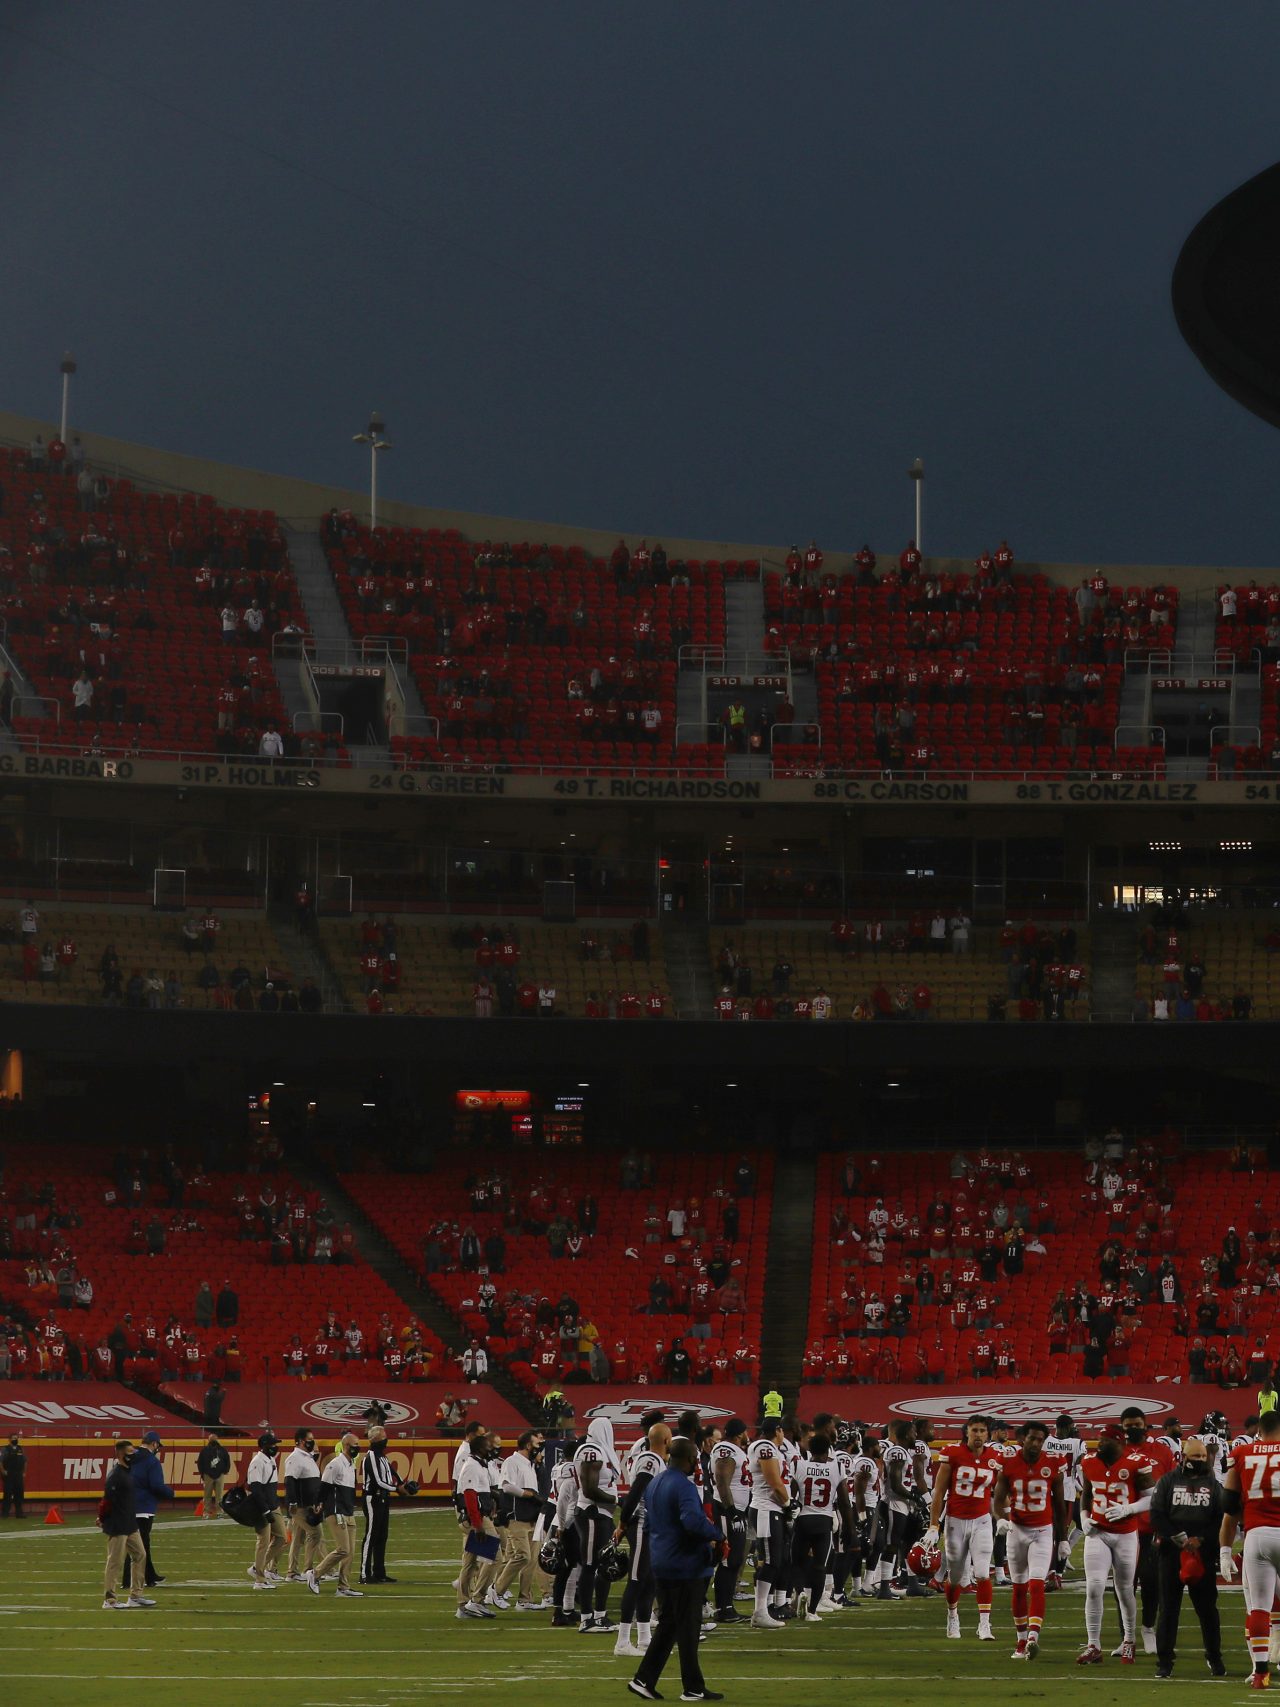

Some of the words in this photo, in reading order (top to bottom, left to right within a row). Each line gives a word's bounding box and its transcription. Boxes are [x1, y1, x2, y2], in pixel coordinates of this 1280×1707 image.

[807, 554, 815, 562] 10
[999, 553, 1008, 561] 15
[1094, 581, 1103, 589] 15
[640, 623, 650, 632] 35
[356, 667, 381, 677] 310
[712, 676, 737, 686] 310
[757, 676, 781, 686] 311
[1157, 679, 1180, 688] 311
[1202, 679, 1226, 688] 312
[917, 750, 927, 758] 15
[25, 757, 133, 780] BARBARO
[182, 766, 200, 782] 31
[205, 767, 222, 784] P.
[229, 765, 321, 788] HOLMES
[369, 775, 393, 789] 24
[430, 776, 505, 794] GREEN
[554, 779, 579, 794] 49
[584, 779, 603, 796] T.
[610, 780, 761, 799] RICHARDSON
[814, 784, 838, 798] 88
[844, 782, 866, 800] C.
[871, 784, 968, 801] CARSON
[1017, 784, 1041, 800] 88
[1047, 784, 1063, 800] T.
[1069, 783, 1197, 800] GONZALEZ
[1245, 785, 1270, 800] 54
[204, 919, 215, 929] 15
[840, 924, 846, 934] 7
[1168, 937, 1177, 946] 15
[62, 944, 72, 954] 15
[503, 945, 514, 954] 15
[367, 959, 377, 968] 15
[1069, 969, 1080, 980] 82
[650, 999, 661, 1008] 15
[720, 1001, 731, 1010] 58
[815, 1000, 825, 1012] 15
[475, 1190, 484, 1200] 10
[295, 1208, 305, 1218] 15
[1113, 1204, 1123, 1213] 87
[961, 1227, 969, 1236] 15
[963, 1272, 974, 1282] 87
[697, 1283, 708, 1294] 25
[1163, 1280, 1173, 1289] 20
[957, 1303, 966, 1312] 15
[46, 1326, 56, 1337] 15
[147, 1328, 155, 1337] 15
[170, 1328, 181, 1338] 14
[53, 1346, 63, 1356] 87
[316, 1344, 327, 1354] 37
[977, 1345, 989, 1355] 32
[542, 1354, 555, 1364] 87
[838, 1355, 847, 1364] 15
[998, 1356, 1008, 1365] 10
[943, 1399, 1116, 1416] Ford
[583, 1451, 597, 1462] 78
[759, 1449, 773, 1459] 66
[891, 1452, 903, 1461] 50
[63, 1458, 104, 1480] THIS
[645, 1462, 653, 1471] 9
[860, 1464, 871, 1473] 40
[806, 1467, 830, 1477] COOKS
[955, 1466, 994, 1498] 87
[803, 1478, 832, 1507] 13
[1013, 1478, 1048, 1512] 19
[1091, 1481, 1130, 1515] 53
[1172, 1491, 1211, 1507] CHIEFS
